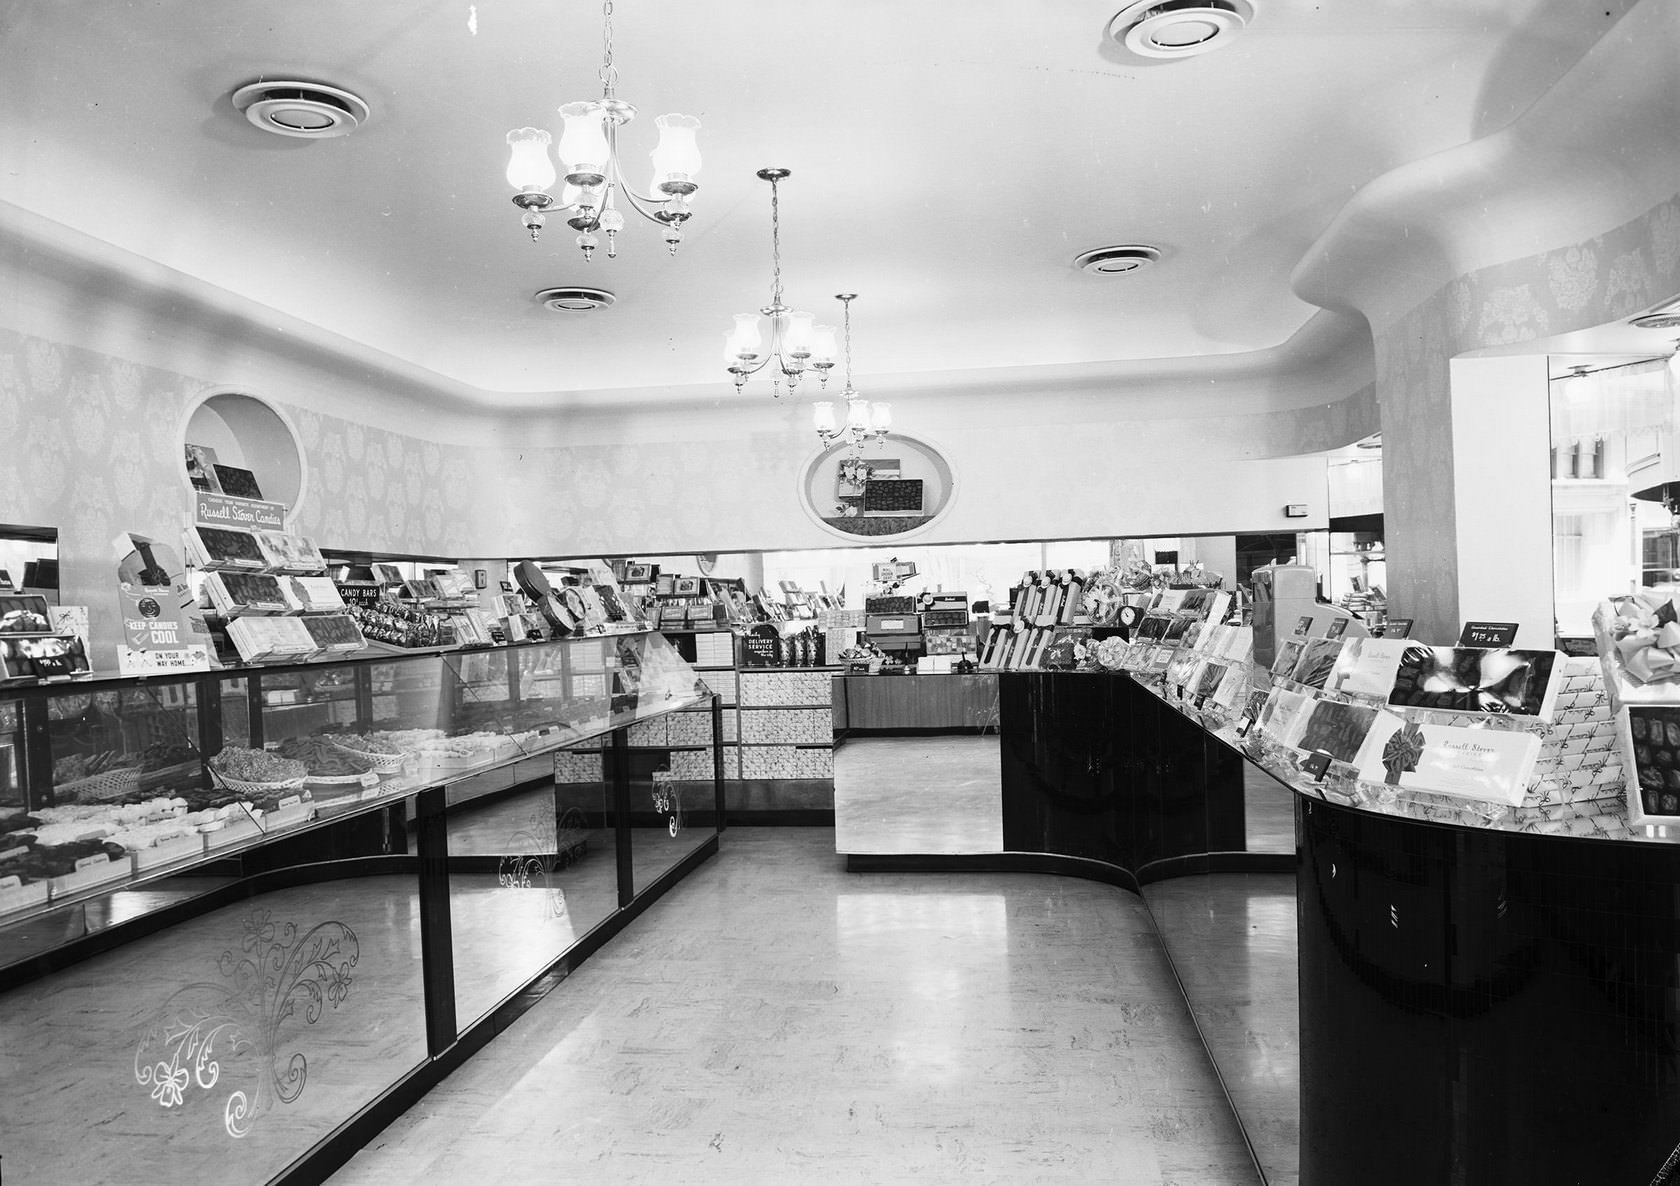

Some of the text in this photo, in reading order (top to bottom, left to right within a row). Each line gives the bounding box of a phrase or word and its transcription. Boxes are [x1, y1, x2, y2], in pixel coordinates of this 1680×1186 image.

[200, 503, 281, 525] Russell Stover Candies
[340, 588, 377, 597] CANDY BARS
[149, 621, 178, 630] CANDIES
[151, 630, 179, 644] COOL
